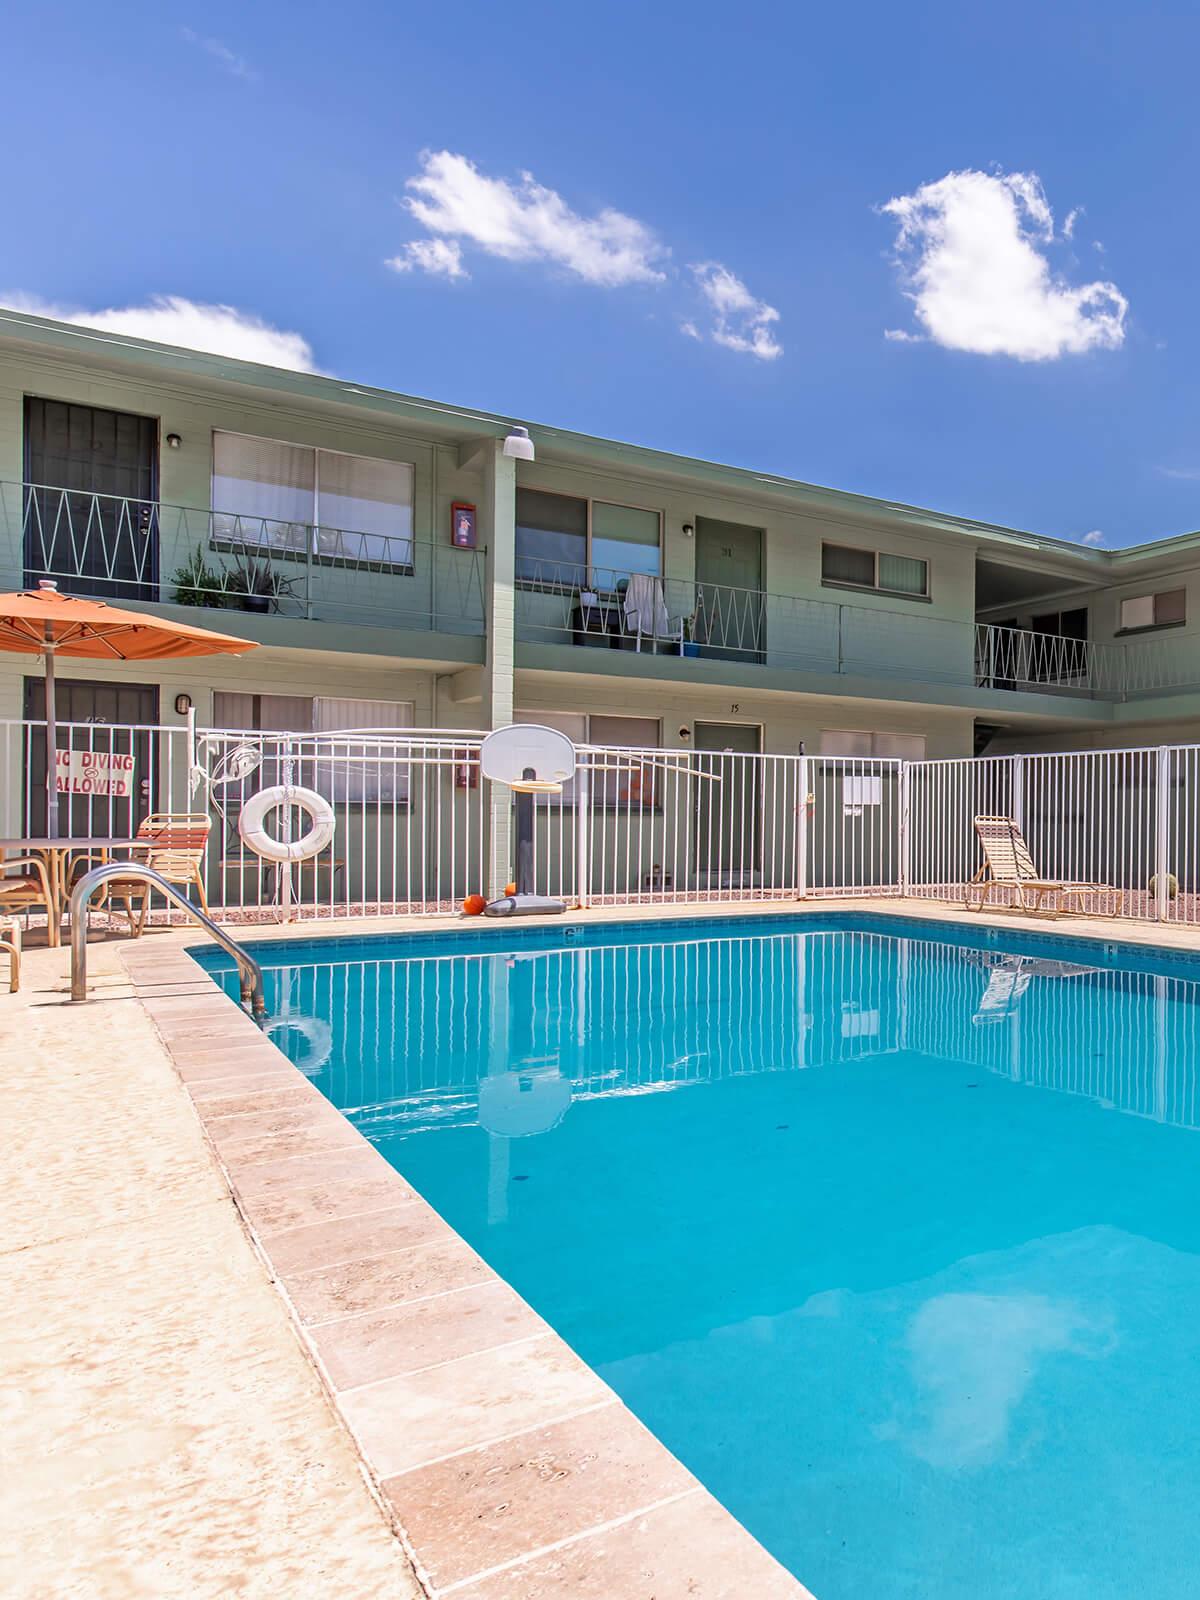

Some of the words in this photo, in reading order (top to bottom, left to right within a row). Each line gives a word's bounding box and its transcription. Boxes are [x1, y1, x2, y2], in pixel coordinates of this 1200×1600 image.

[731, 703, 740, 713] 15
[81, 752, 133, 770] DIVING
[55, 775, 126, 795] ALLOWED
